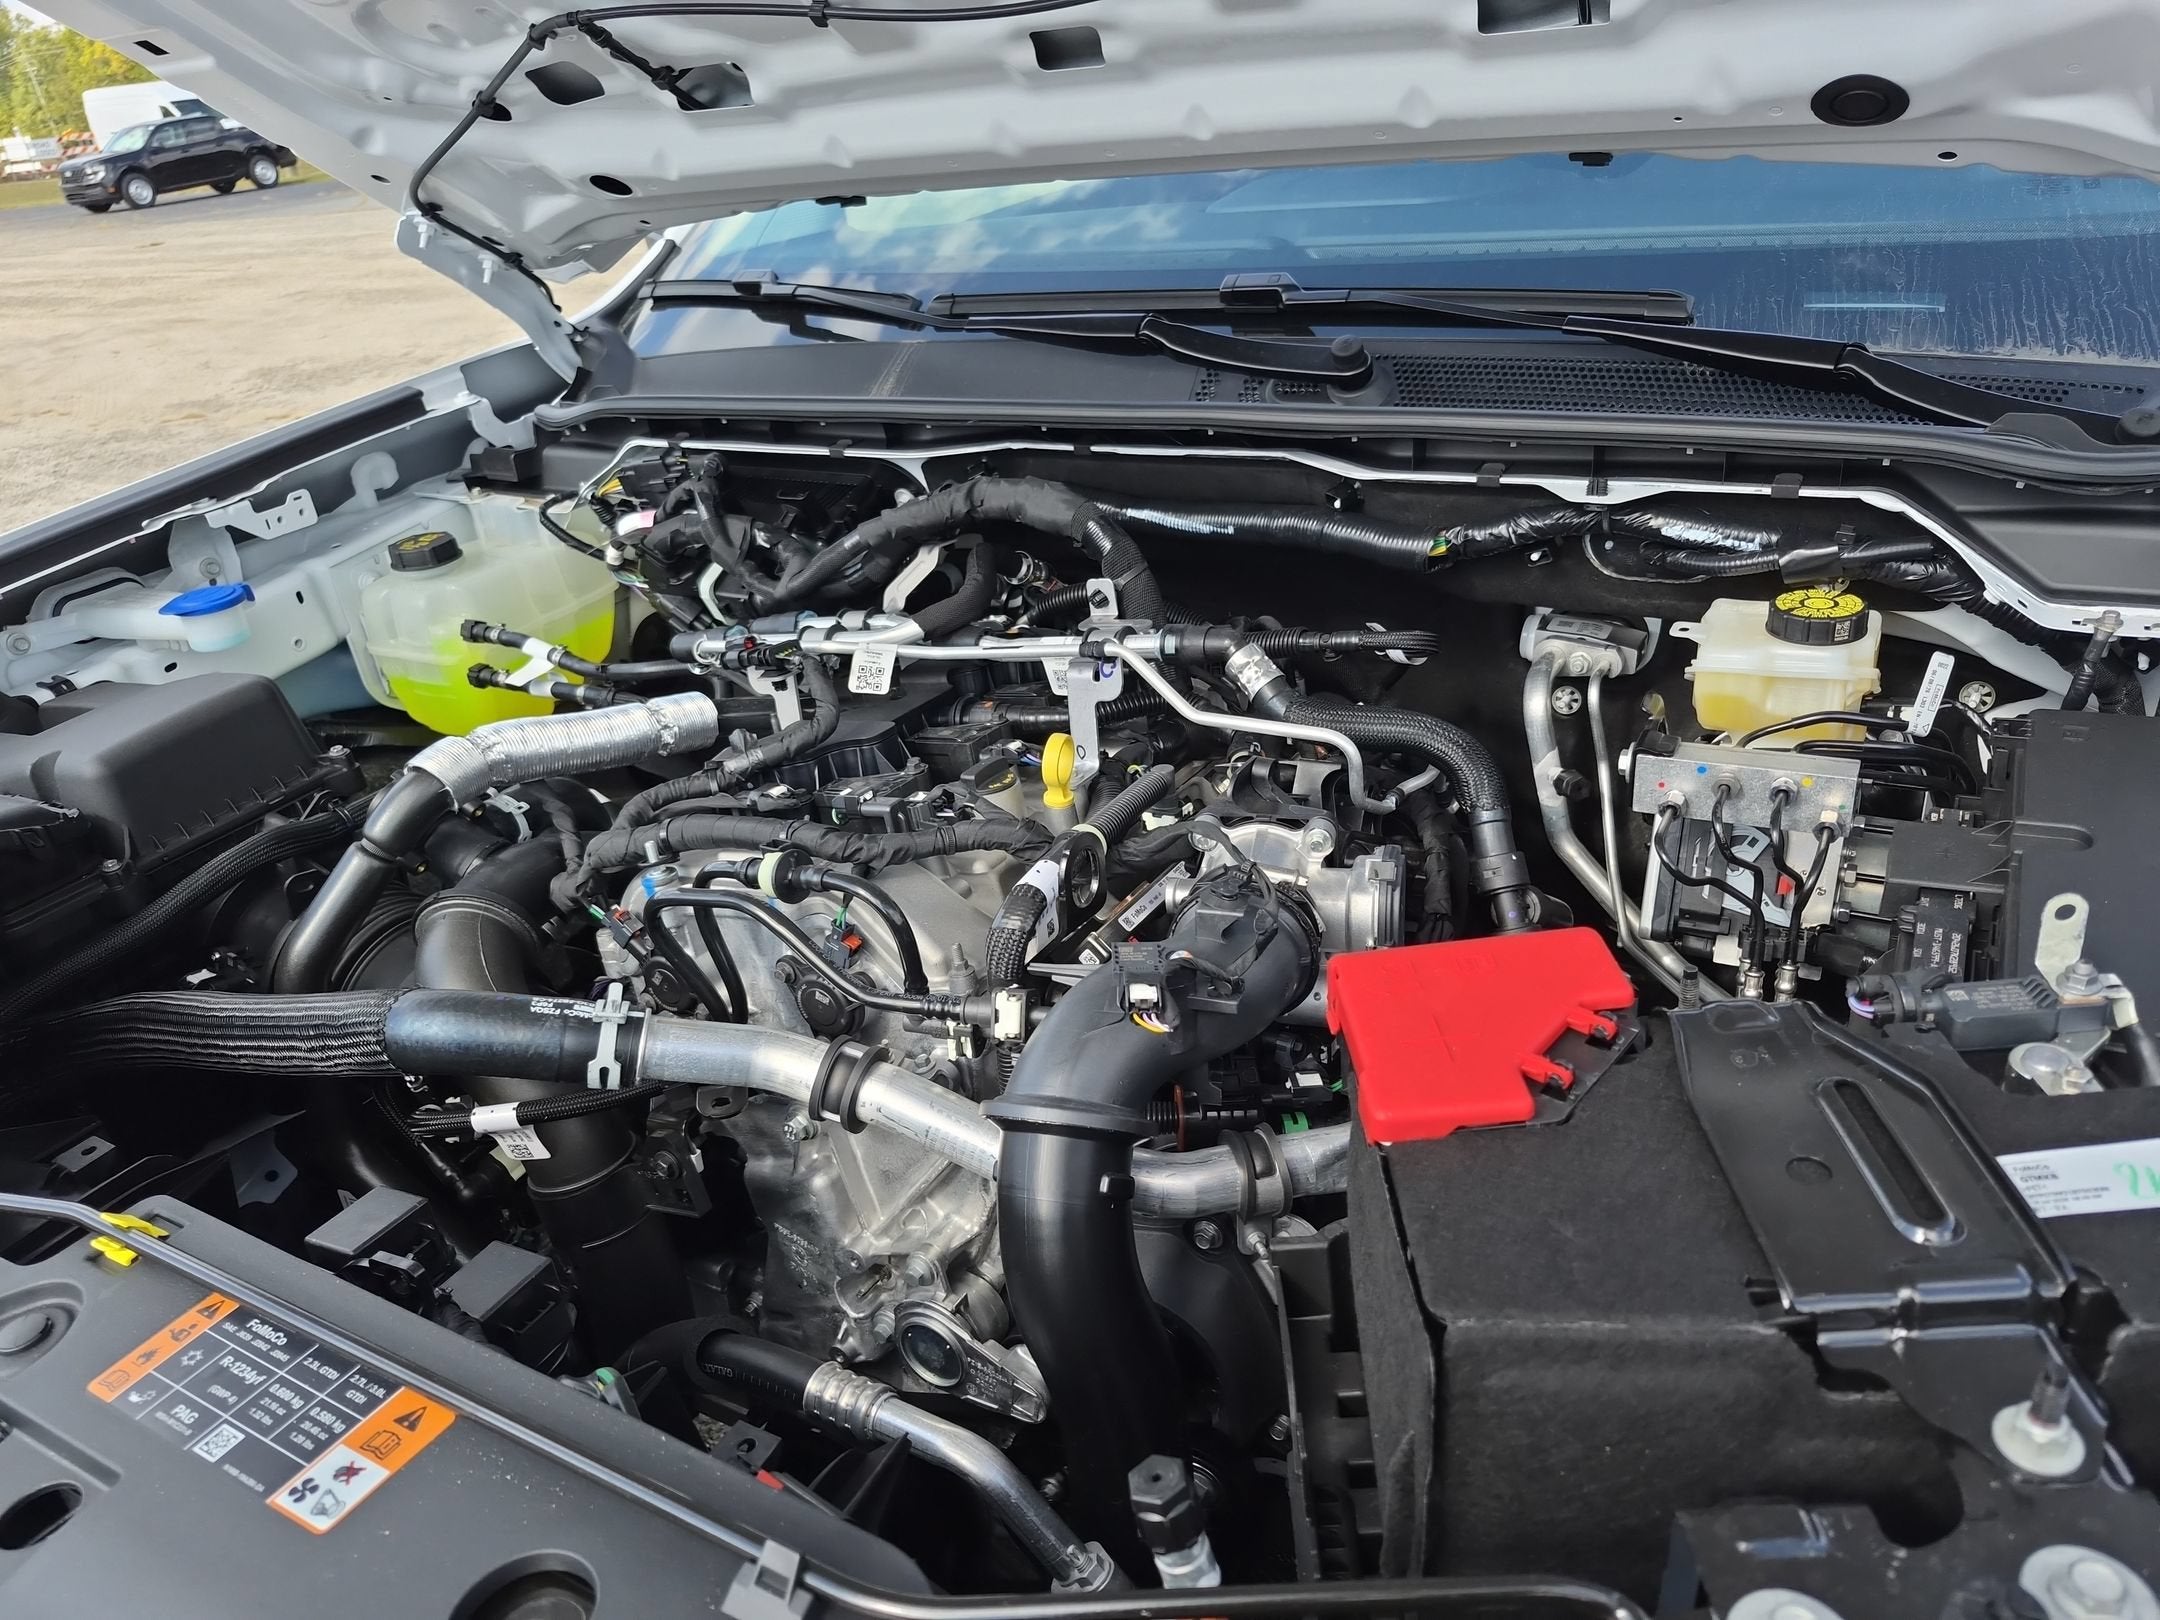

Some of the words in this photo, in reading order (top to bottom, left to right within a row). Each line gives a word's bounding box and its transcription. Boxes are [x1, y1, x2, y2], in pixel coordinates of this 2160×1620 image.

[222, 1321, 239, 1334] SAE
[246, 1318, 288, 1346] FoMoCo
[218, 1355, 268, 1386] R-1234yf
[319, 1365, 341, 1381] GTDI
[289, 1395, 305, 1410] kg
[345, 1389, 368, 1404] GTDI
[170, 1404, 200, 1425] PAG
[331, 1419, 346, 1434] kg
